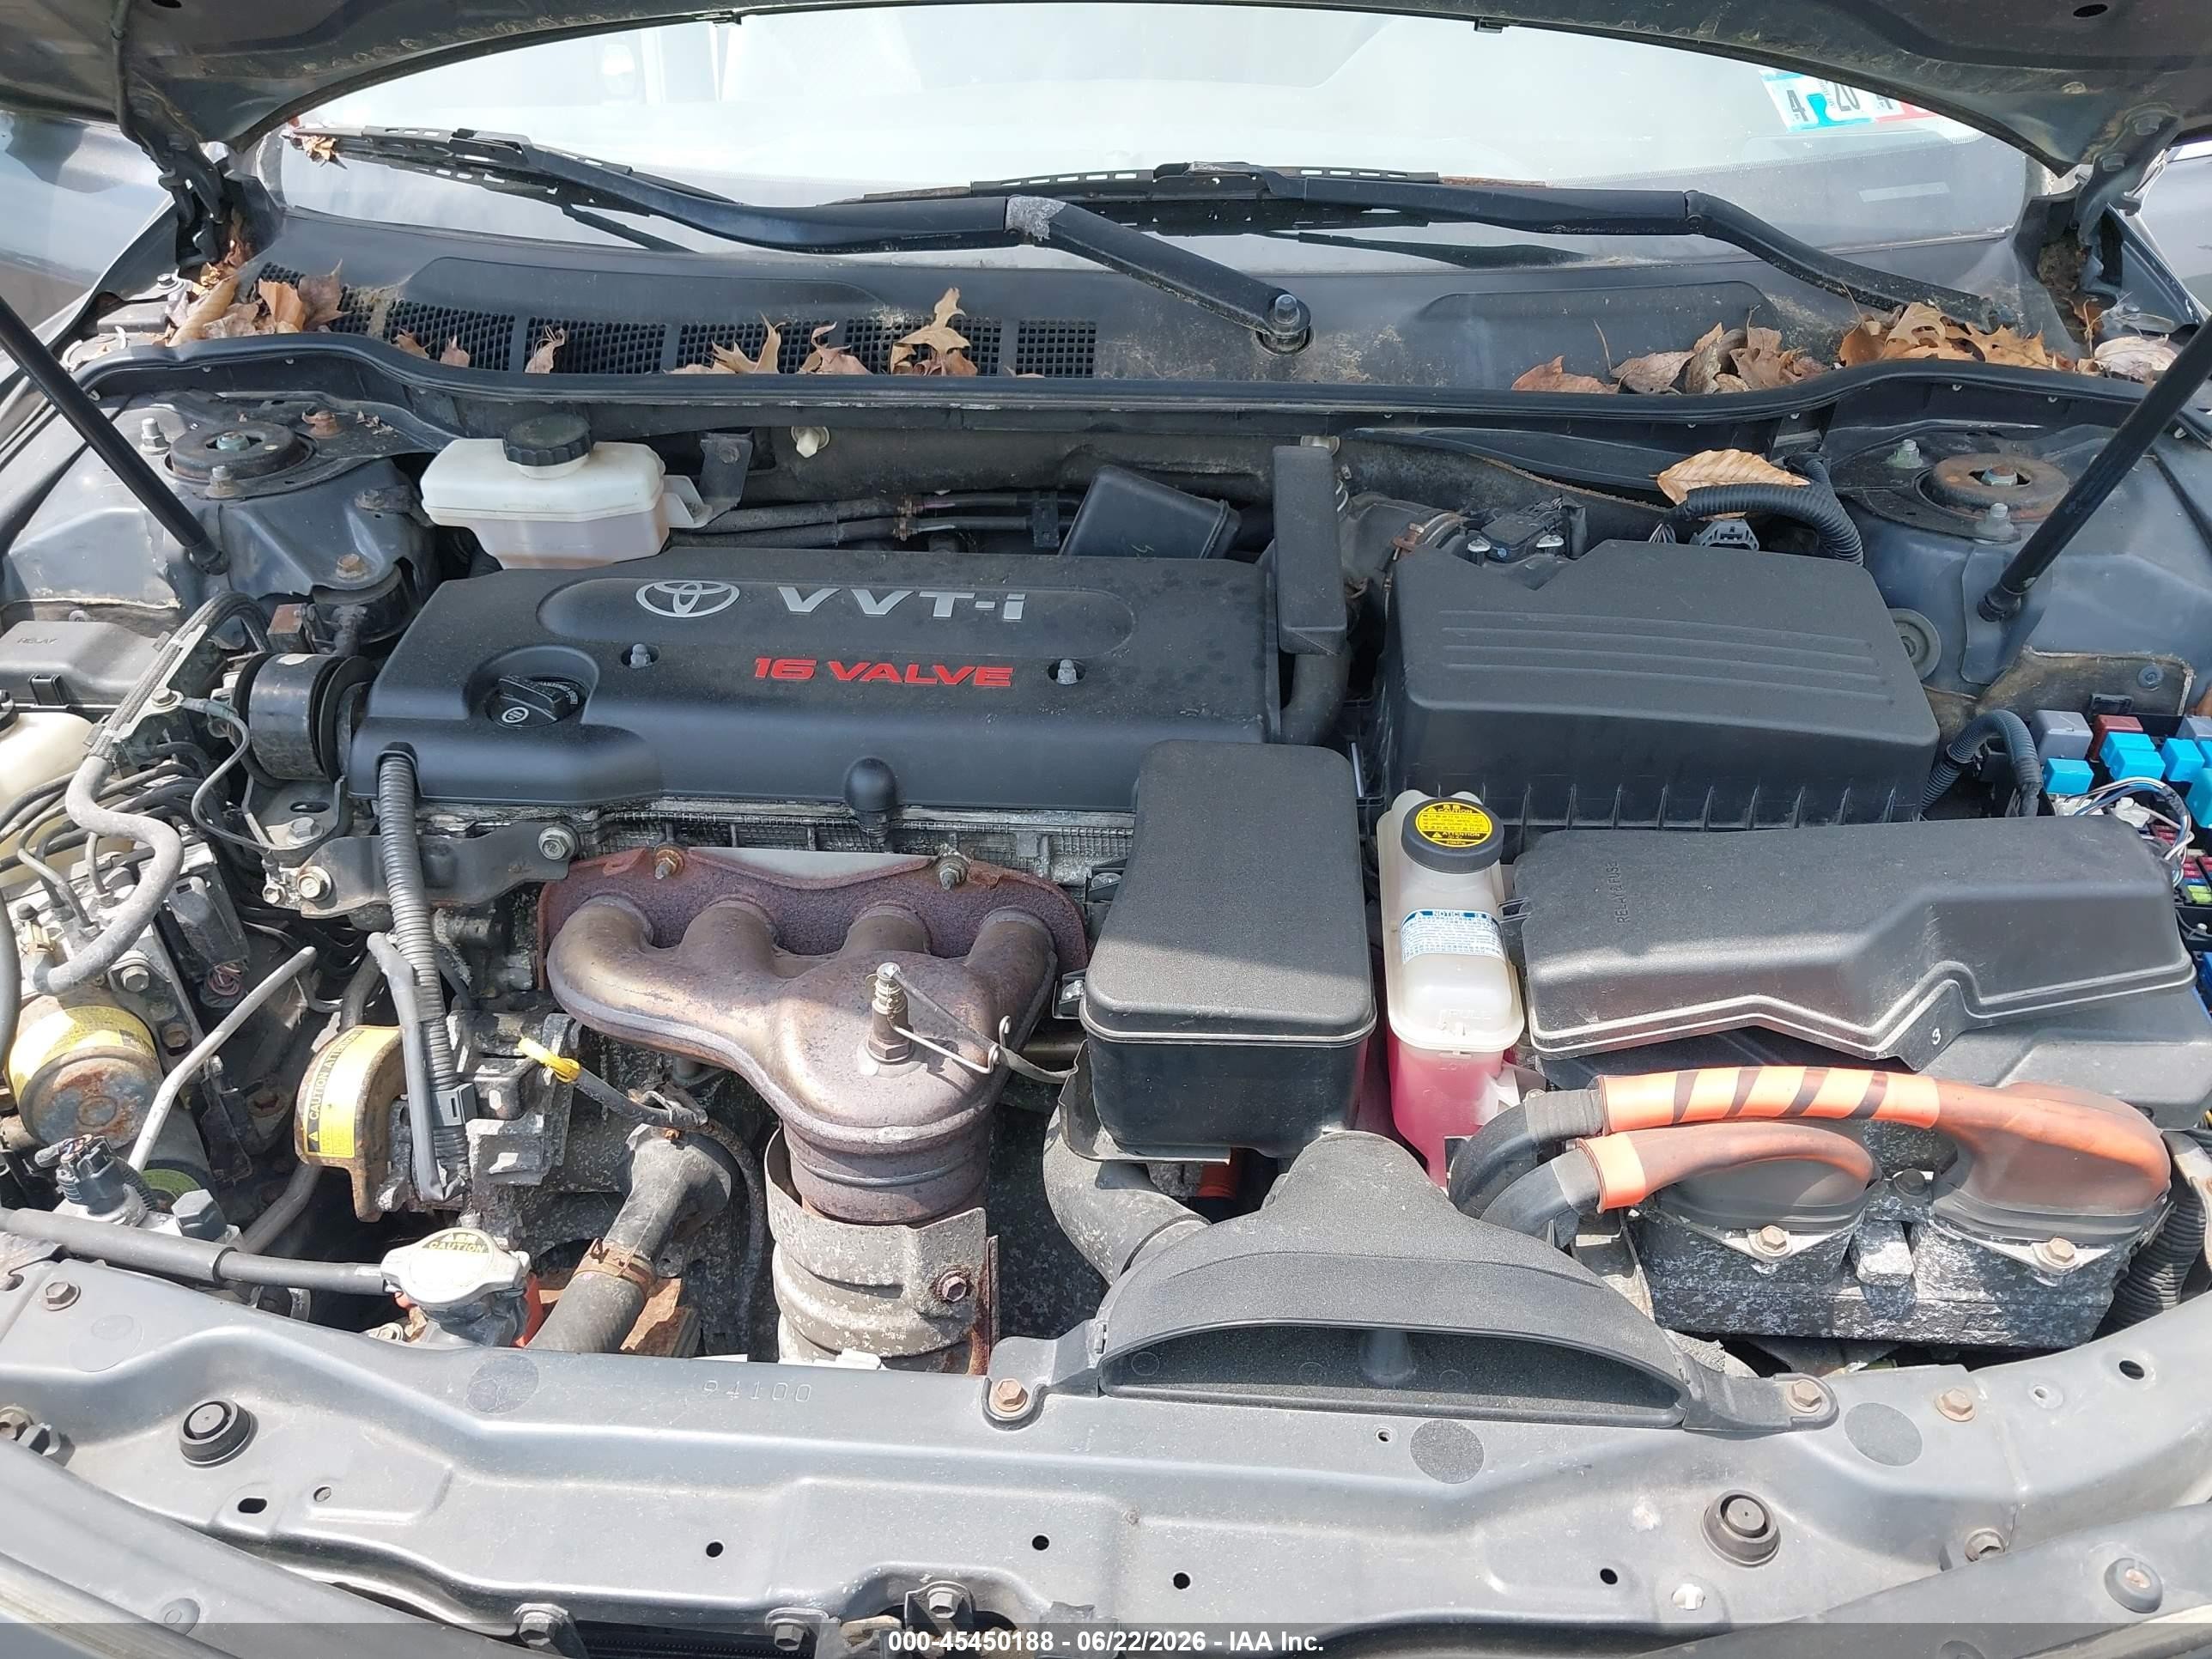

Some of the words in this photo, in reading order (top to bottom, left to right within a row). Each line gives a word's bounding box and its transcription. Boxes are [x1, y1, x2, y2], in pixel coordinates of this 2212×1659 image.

[778, 587, 1026, 621] VVT-i
[755, 658, 818, 679] 16
[827, 660, 1014, 687] VALVE
[308, 1072, 329, 1120] CAUTION
[428, 1241, 485, 1253] CAUTION
